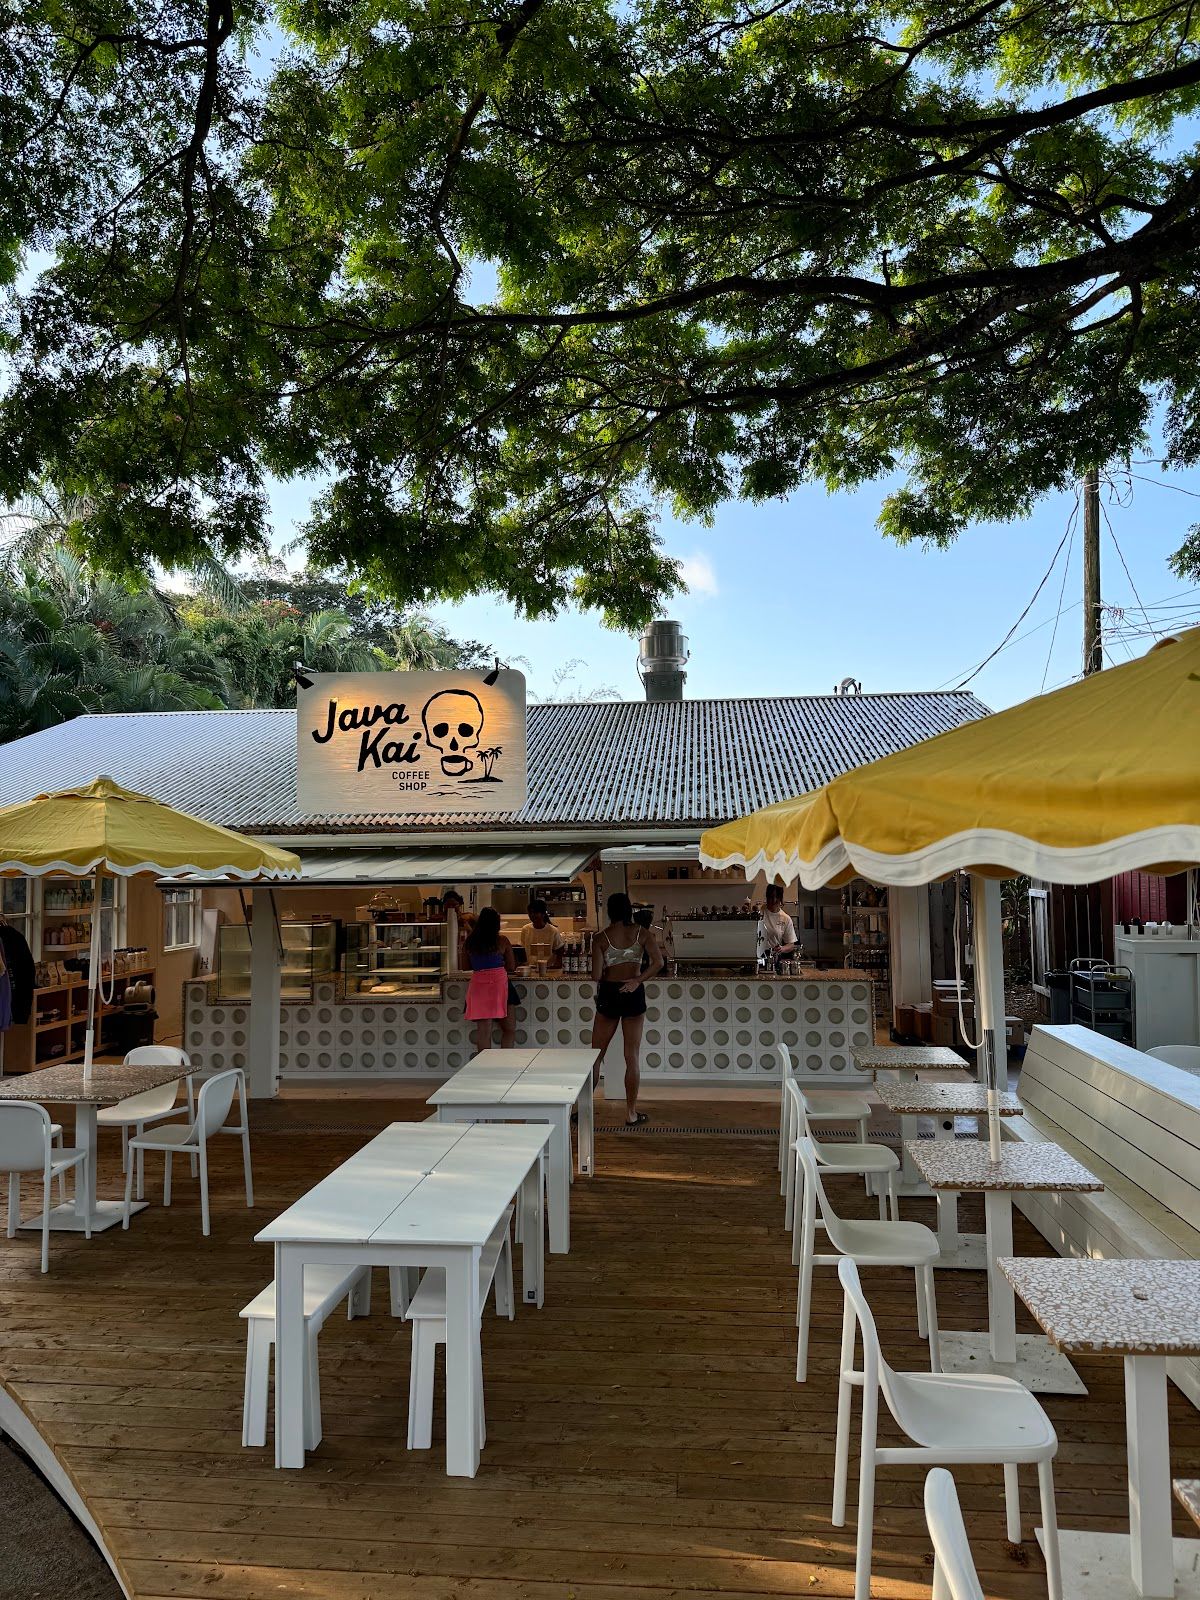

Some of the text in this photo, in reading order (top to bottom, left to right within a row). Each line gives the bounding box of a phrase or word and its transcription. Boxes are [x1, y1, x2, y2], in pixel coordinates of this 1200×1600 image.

[312, 697, 410, 744] Java
[357, 727, 423, 772] Kai
[392, 770, 430, 780] COFFEE
[399, 782, 427, 791] SHOP
